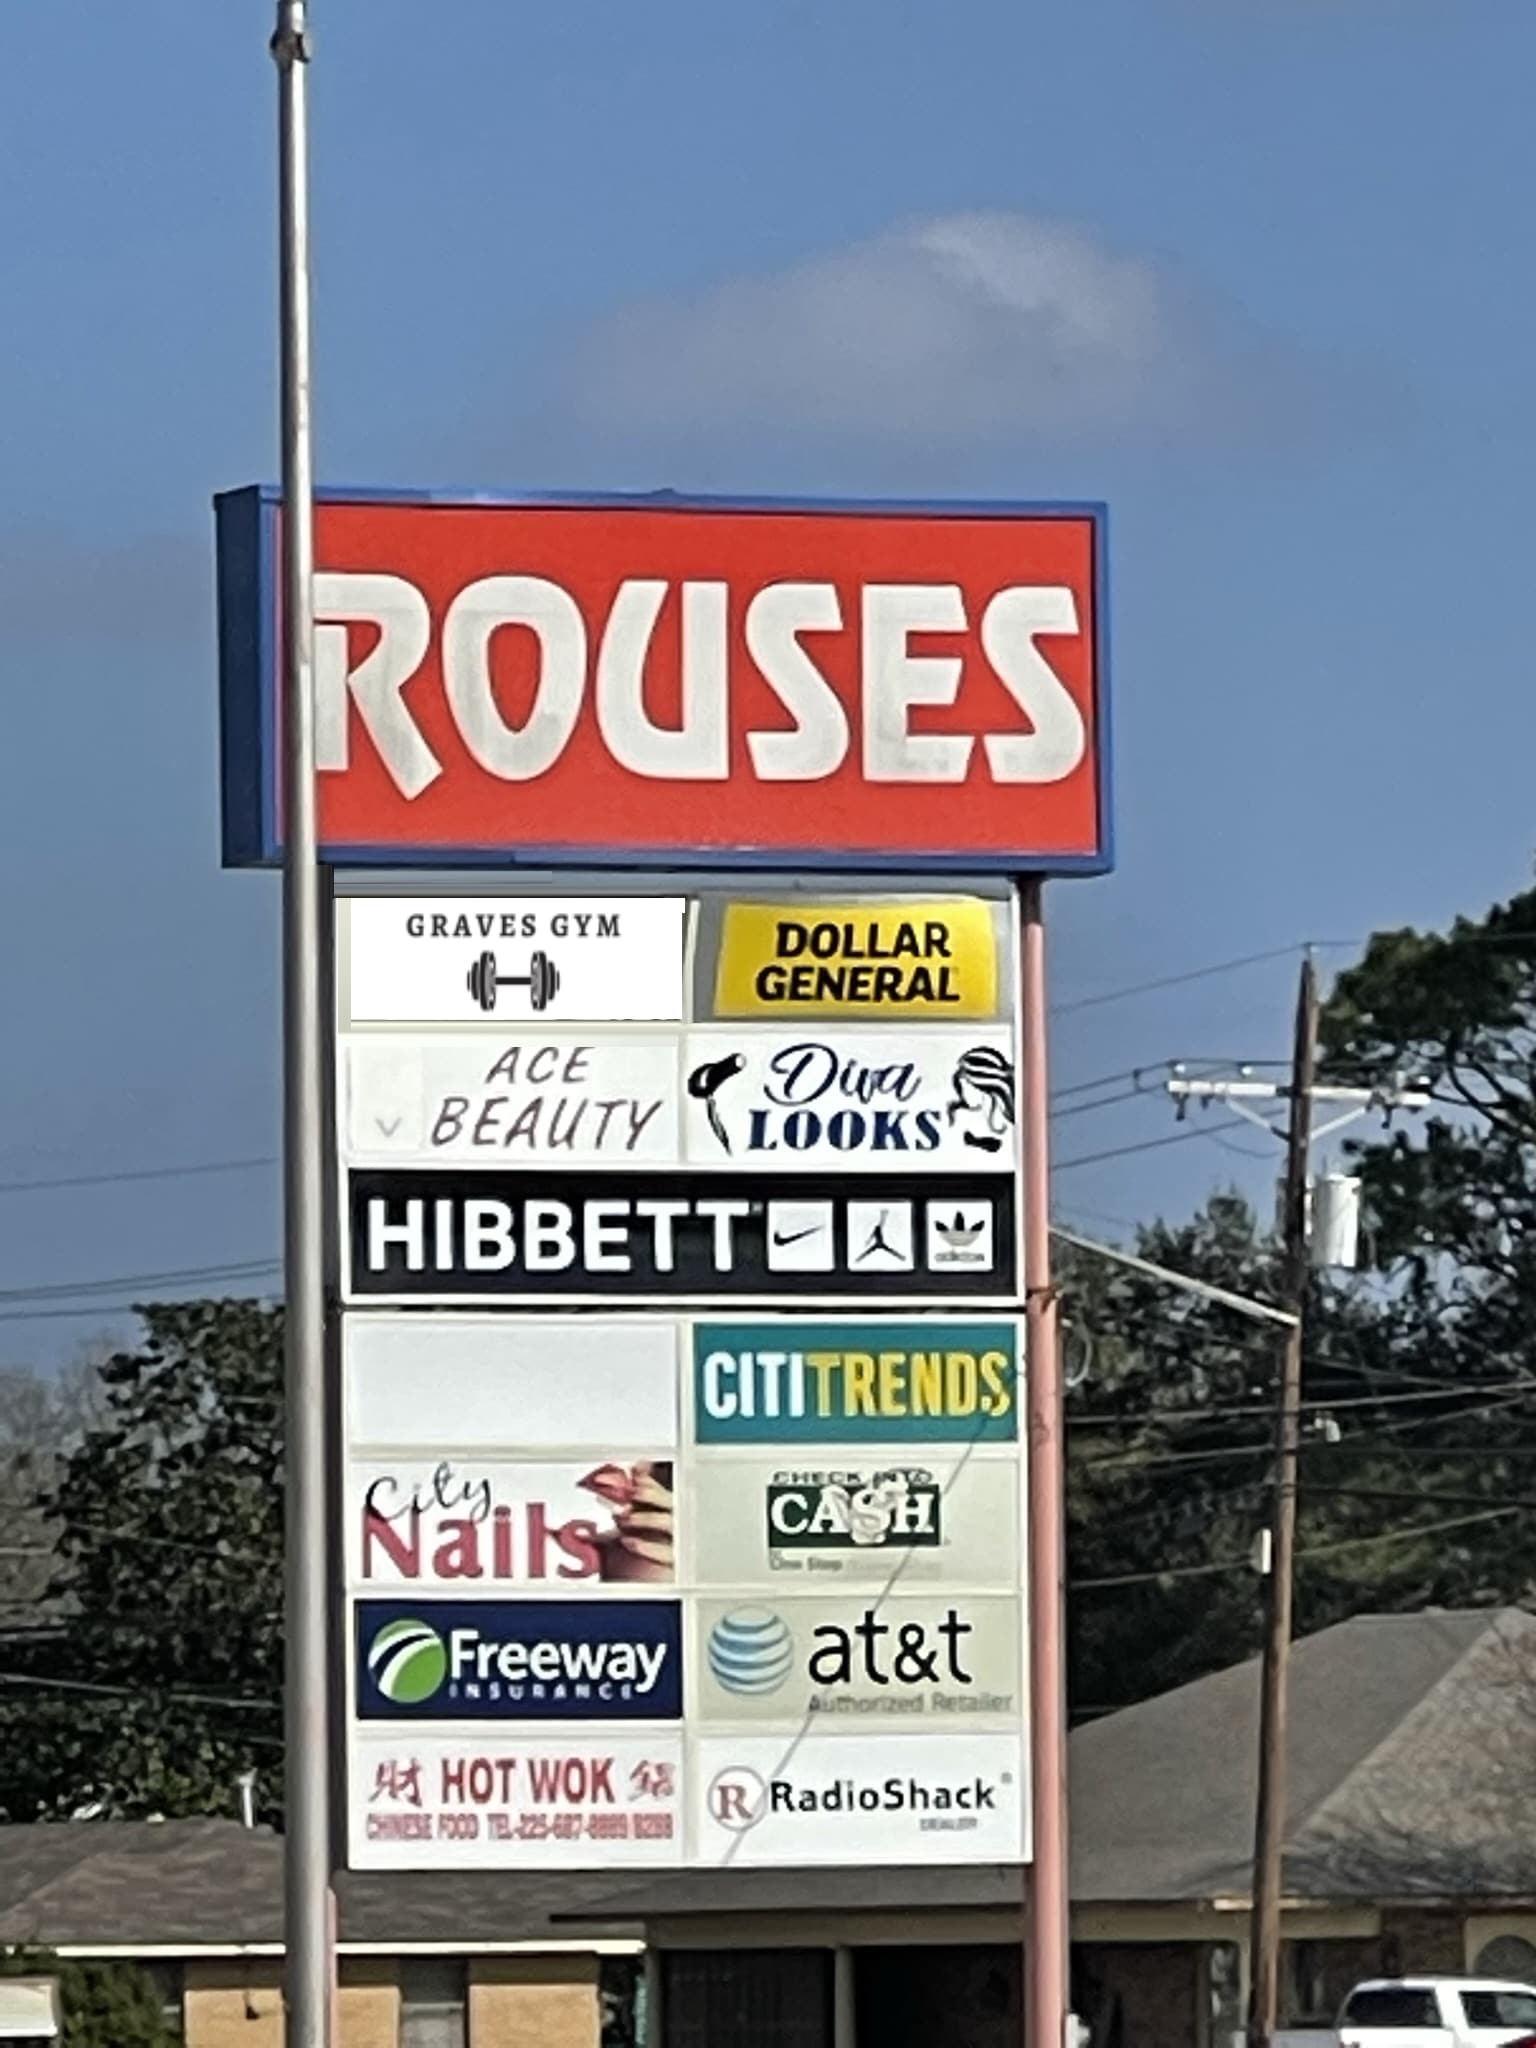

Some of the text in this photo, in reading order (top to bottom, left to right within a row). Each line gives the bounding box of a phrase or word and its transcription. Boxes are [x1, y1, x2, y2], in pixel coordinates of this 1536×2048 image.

[313, 572, 1086, 800] ROUSES
[406, 913, 622, 937] GRAVES GYM
[776, 922, 952, 958] DOLLAR
[755, 965, 961, 1002] GENERAL
[485, 1046, 597, 1085] ACE
[763, 1042, 922, 1107] Diva
[431, 1096, 664, 1152] BEAUTY
[747, 1109, 943, 1152] LOOKS
[367, 1199, 751, 1272] HIBBETT
[364, 1461, 492, 1524] City
[770, 1486, 935, 1545] CASH
[361, 1502, 602, 1580] Nails
[450, 1628, 667, 1693] Freeway
[808, 1610, 973, 1685] at&t
[449, 1682, 633, 1700] INSURANCE
[808, 1692, 1013, 1713] Authorized Retailer
[441, 1757, 516, 1804] HOT
[527, 1757, 616, 1804] WOK
[769, 1777, 997, 1813] RadioShack
